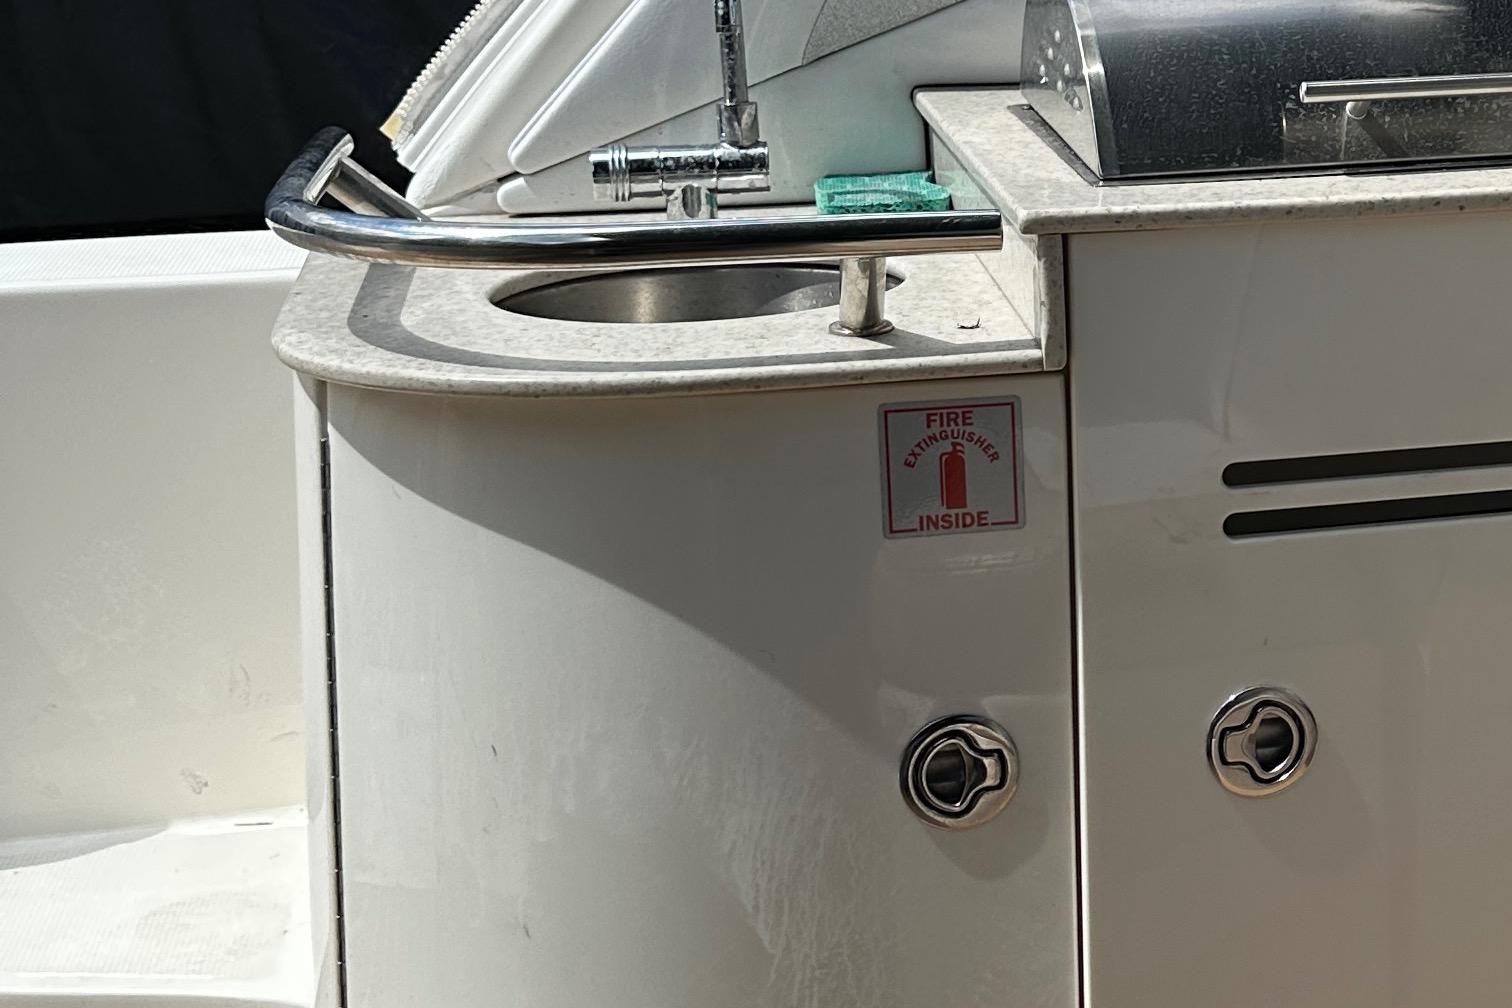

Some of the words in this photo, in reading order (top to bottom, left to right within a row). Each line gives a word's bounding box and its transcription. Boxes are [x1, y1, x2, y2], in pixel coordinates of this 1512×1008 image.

[925, 410, 974, 429] FIRE
[903, 428, 1000, 469] EXTINGUISHER
[918, 510, 989, 532] INSIDE
